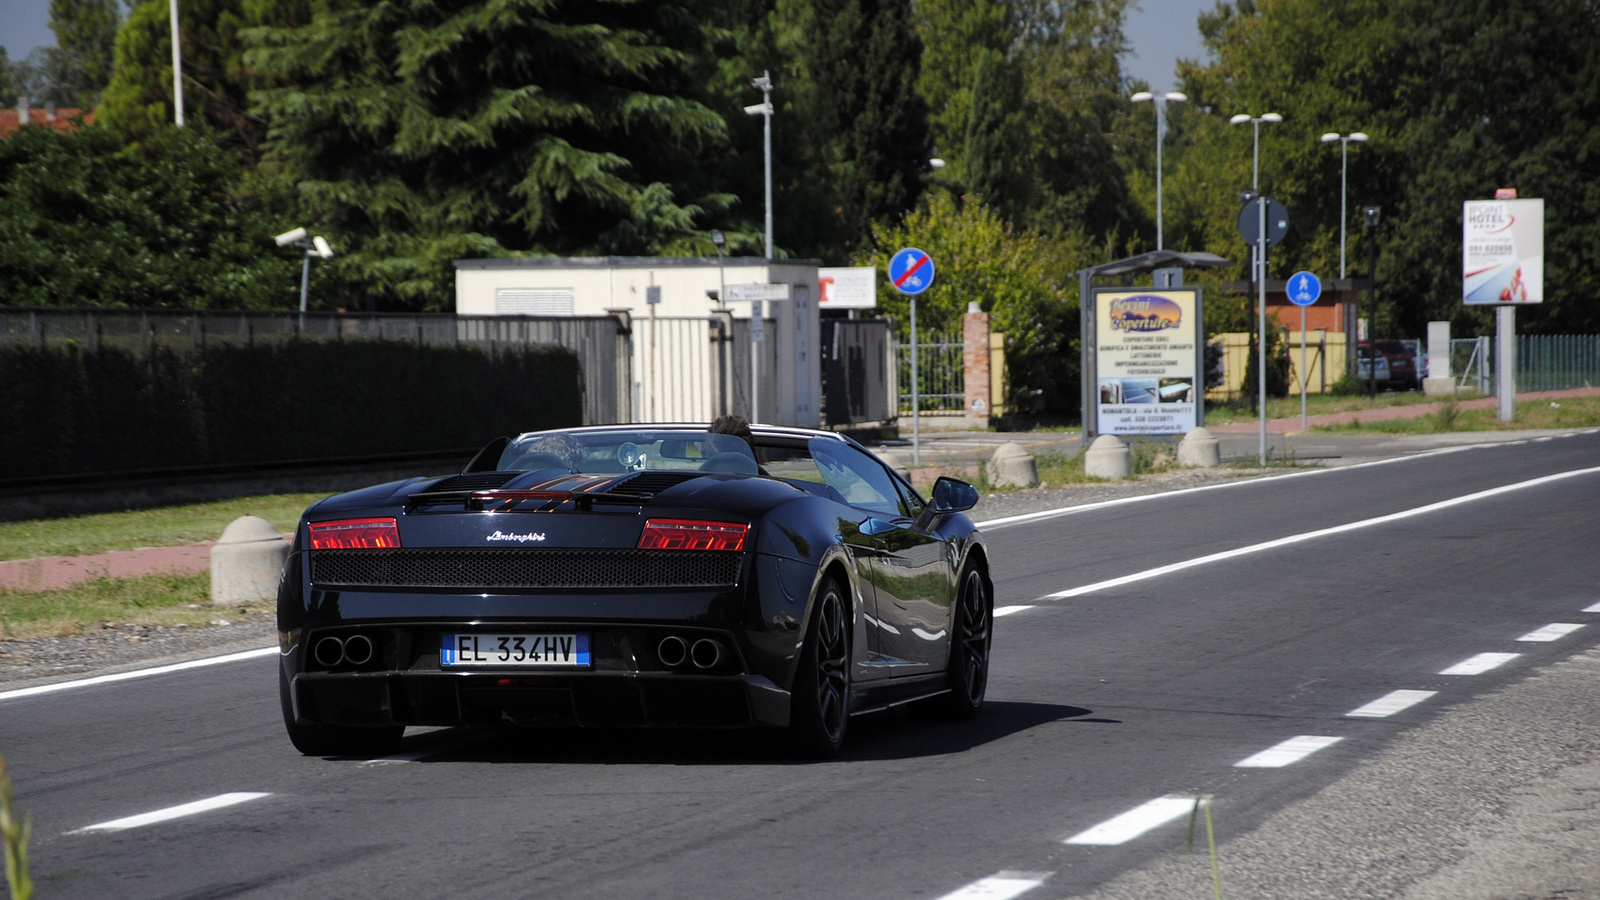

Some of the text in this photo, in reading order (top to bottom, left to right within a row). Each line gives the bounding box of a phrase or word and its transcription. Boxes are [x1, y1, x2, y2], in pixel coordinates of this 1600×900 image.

[1469, 214, 1504, 223] HOTEL
[1111, 318, 1170, 333] Coperture
[486, 530, 546, 543] Lamborghini
[458, 636, 487, 662] EL
[497, 636, 572, 662] 334HV
